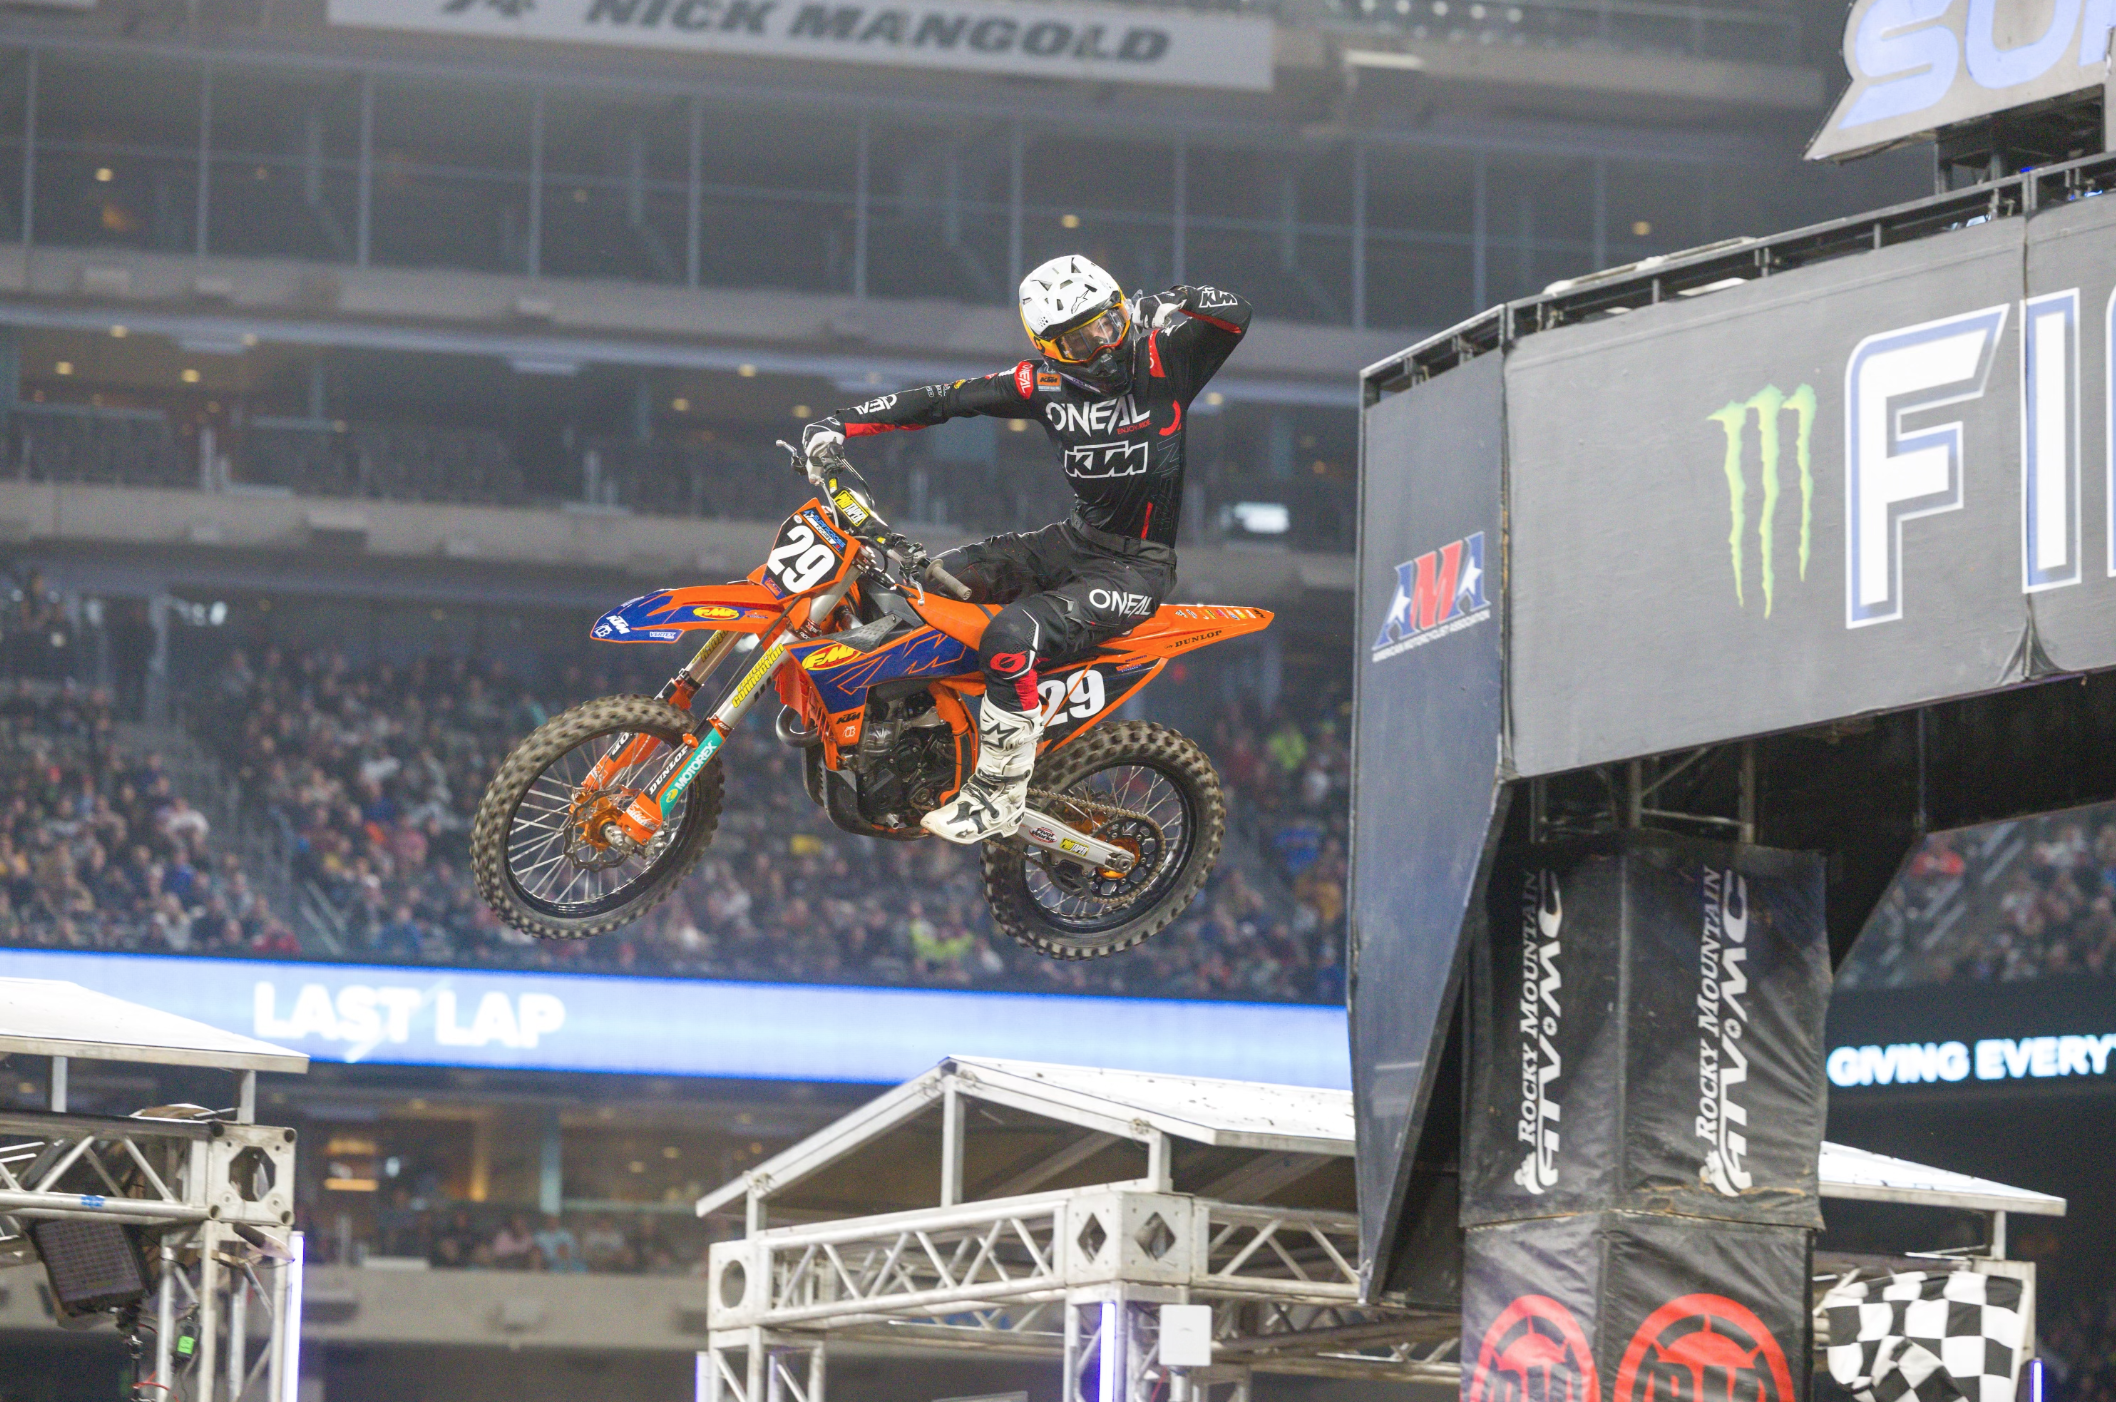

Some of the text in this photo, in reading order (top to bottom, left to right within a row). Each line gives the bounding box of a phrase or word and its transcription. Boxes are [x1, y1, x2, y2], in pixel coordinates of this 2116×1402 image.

[787, 1, 1172, 64] MANGOLD
[1064, 440, 1149, 479] KTM
[1845, 284, 2116, 630] FI
[767, 525, 836, 594] 29
[1371, 531, 1492, 651] AMA
[606, 615, 631, 635] KTM
[1174, 629, 1222, 649] DUNLOP
[836, 711, 861, 725] KTM
[1037, 669, 1106, 728] 29
[649, 745, 689, 796] DUNLOP
[674, 741, 718, 791] MOTOREX
[253, 980, 566, 1050] LAST LAP
[1518, 869, 1540, 1147] ROCKY MOUNTAIN
[1695, 864, 1722, 1146] ROCKY MOUNTAIN
[1826, 1040, 1971, 1088] GIVING
